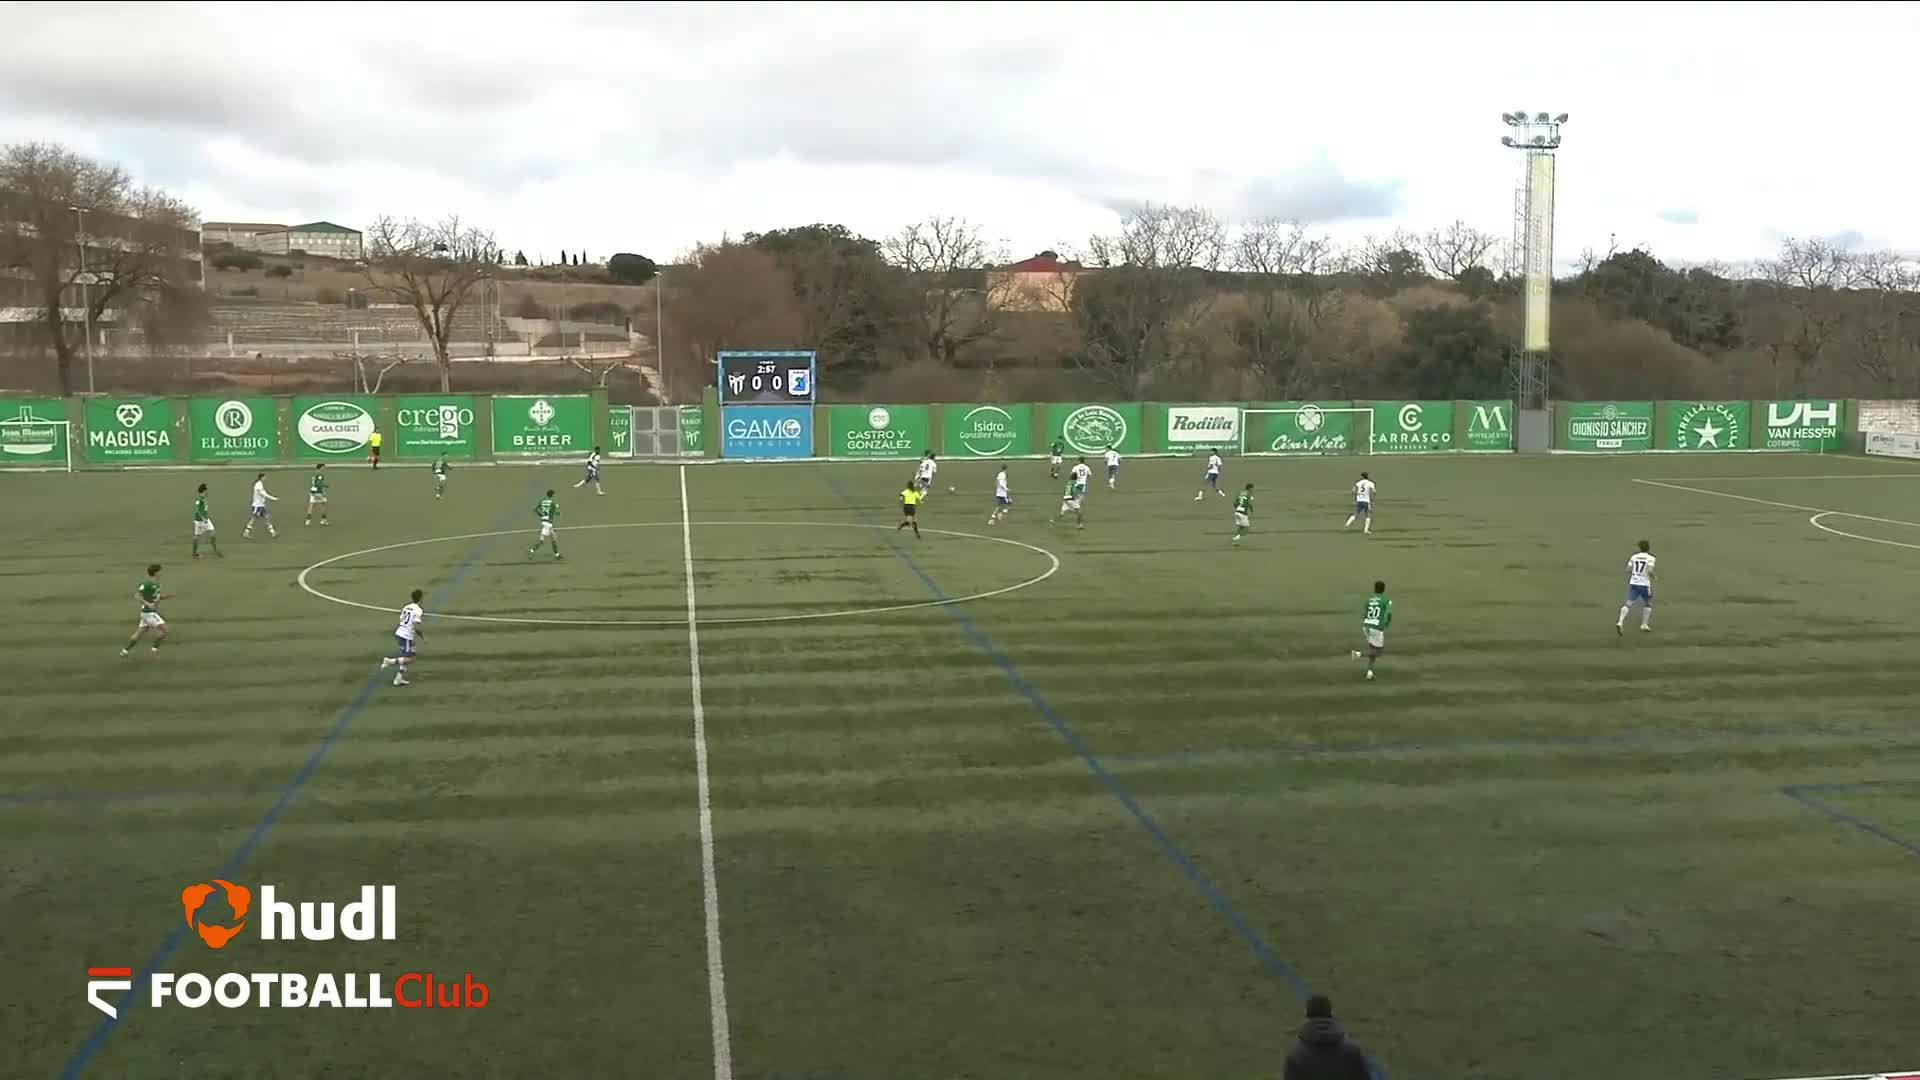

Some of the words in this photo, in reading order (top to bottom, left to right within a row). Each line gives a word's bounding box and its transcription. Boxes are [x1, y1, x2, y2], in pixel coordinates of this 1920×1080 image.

[757, 365, 776, 374] 2:57
[752, 375, 762, 390] 0
[772, 375, 782, 390] 0
[397, 405, 474, 434] crego
[1172, 415, 1233, 431] Rodilla
[1678, 403, 1706, 449] ESTRELLA
[1715, 404, 1739, 449] CASTILLA
[312, 424, 334, 432] CASA
[728, 418, 801, 439] GAMO
[974, 421, 1005, 432] Isidro
[1572, 421, 1609, 437] DIONISIO
[1768, 428, 1791, 439] VAN
[1793, 427, 1836, 439] HESSEN
[90, 430, 170, 447] MAGUISA
[513, 435, 571, 446] BEHER
[847, 430, 895, 440] CASTRO
[897, 430, 906, 439] Y
[1369, 433, 1451, 444] CARRASCO
[201, 437, 220, 449] EL
[223, 437, 269, 449] RUBIO
[1634, 560, 1647, 573] 17
[1367, 606, 1381, 619] 20
